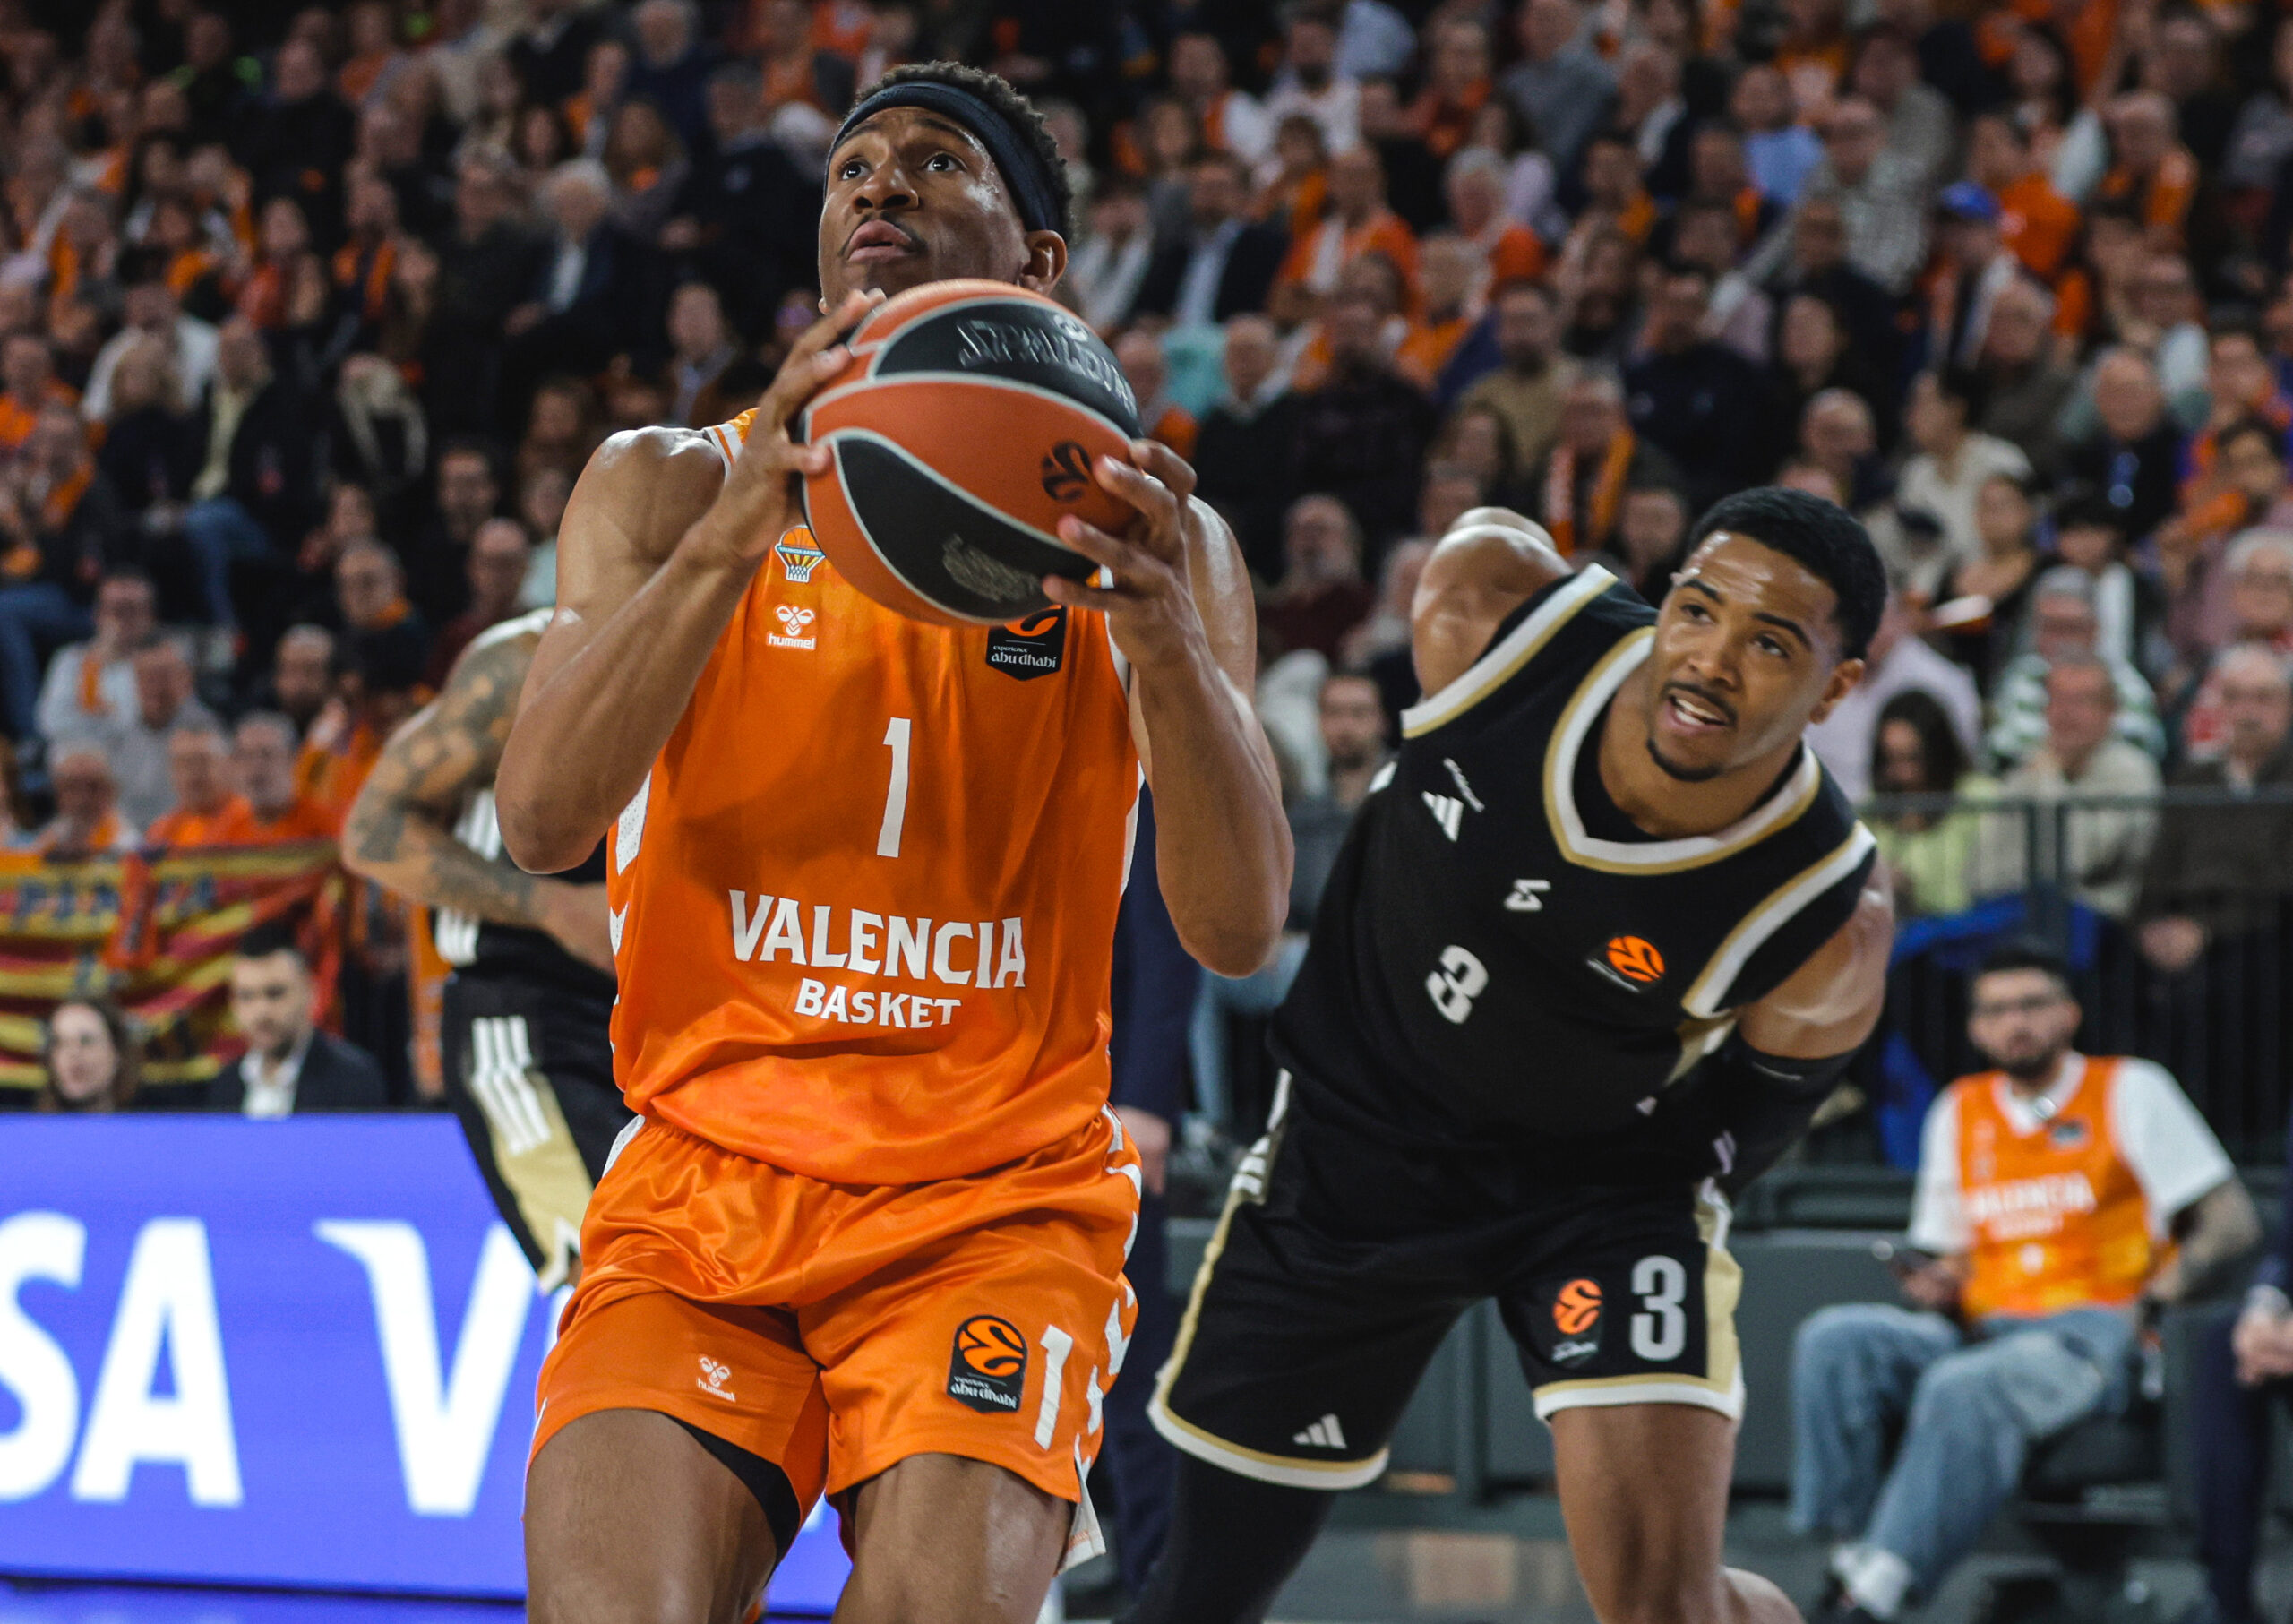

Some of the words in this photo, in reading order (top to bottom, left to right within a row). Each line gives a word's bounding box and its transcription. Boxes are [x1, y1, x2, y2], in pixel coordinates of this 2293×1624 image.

[768, 632, 816, 649] hummel
[991, 651, 1017, 665] abu
[1018, 654, 1057, 668] dhabi
[876, 717, 911, 858] 1
[728, 889, 1026, 990] VALENCIA
[794, 977, 962, 1029] BASKET
[1425, 944, 1489, 1025] 3
[1630, 1254, 1687, 1362] 3
[696, 1377, 735, 1402] hummel
[1034, 1324, 1074, 1450] 1
